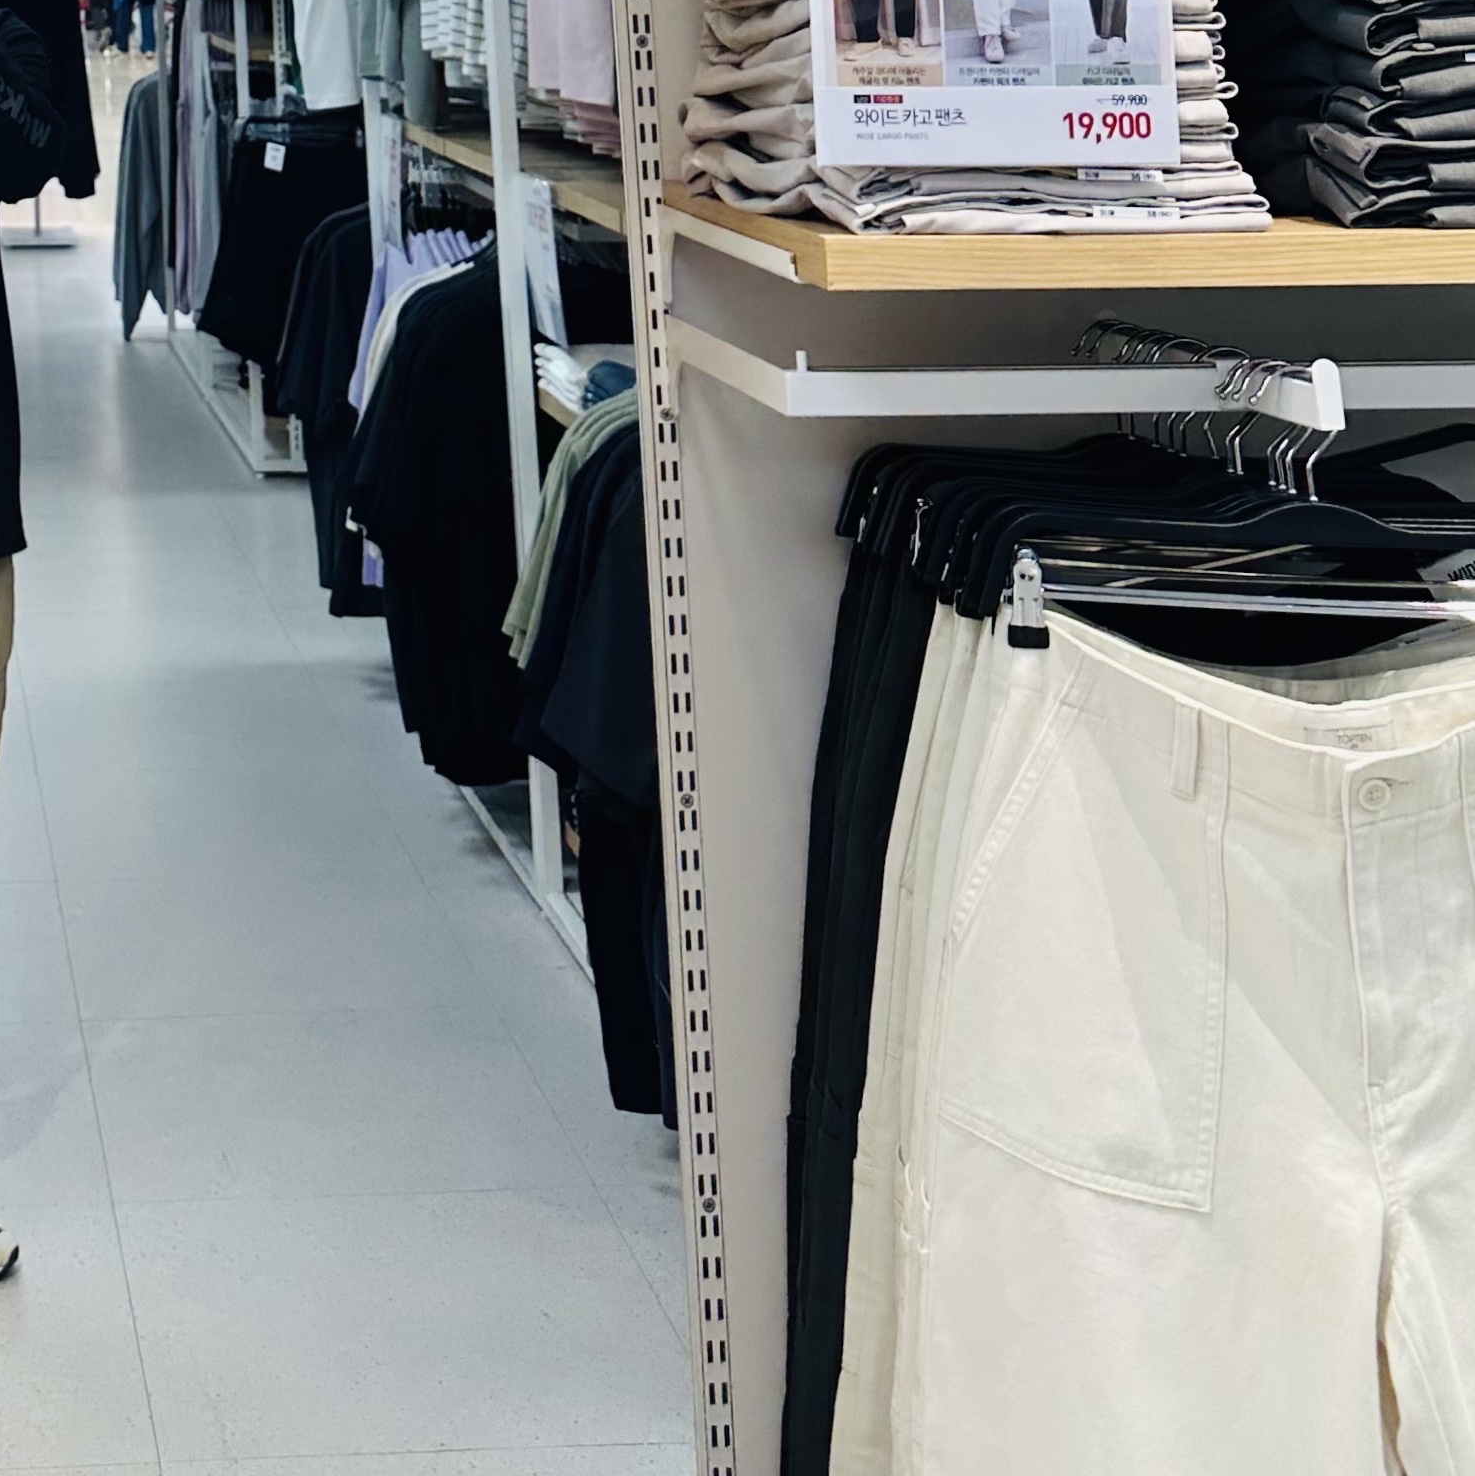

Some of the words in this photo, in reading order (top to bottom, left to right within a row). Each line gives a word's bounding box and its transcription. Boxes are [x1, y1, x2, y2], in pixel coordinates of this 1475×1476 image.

[1111, 94, 1148, 108] 59,900
[854, 108, 901, 127] 와이드
[902, 109, 933, 127] 카고
[935, 109, 967, 127] 팬츠
[1063, 111, 1152, 144] 19,900
